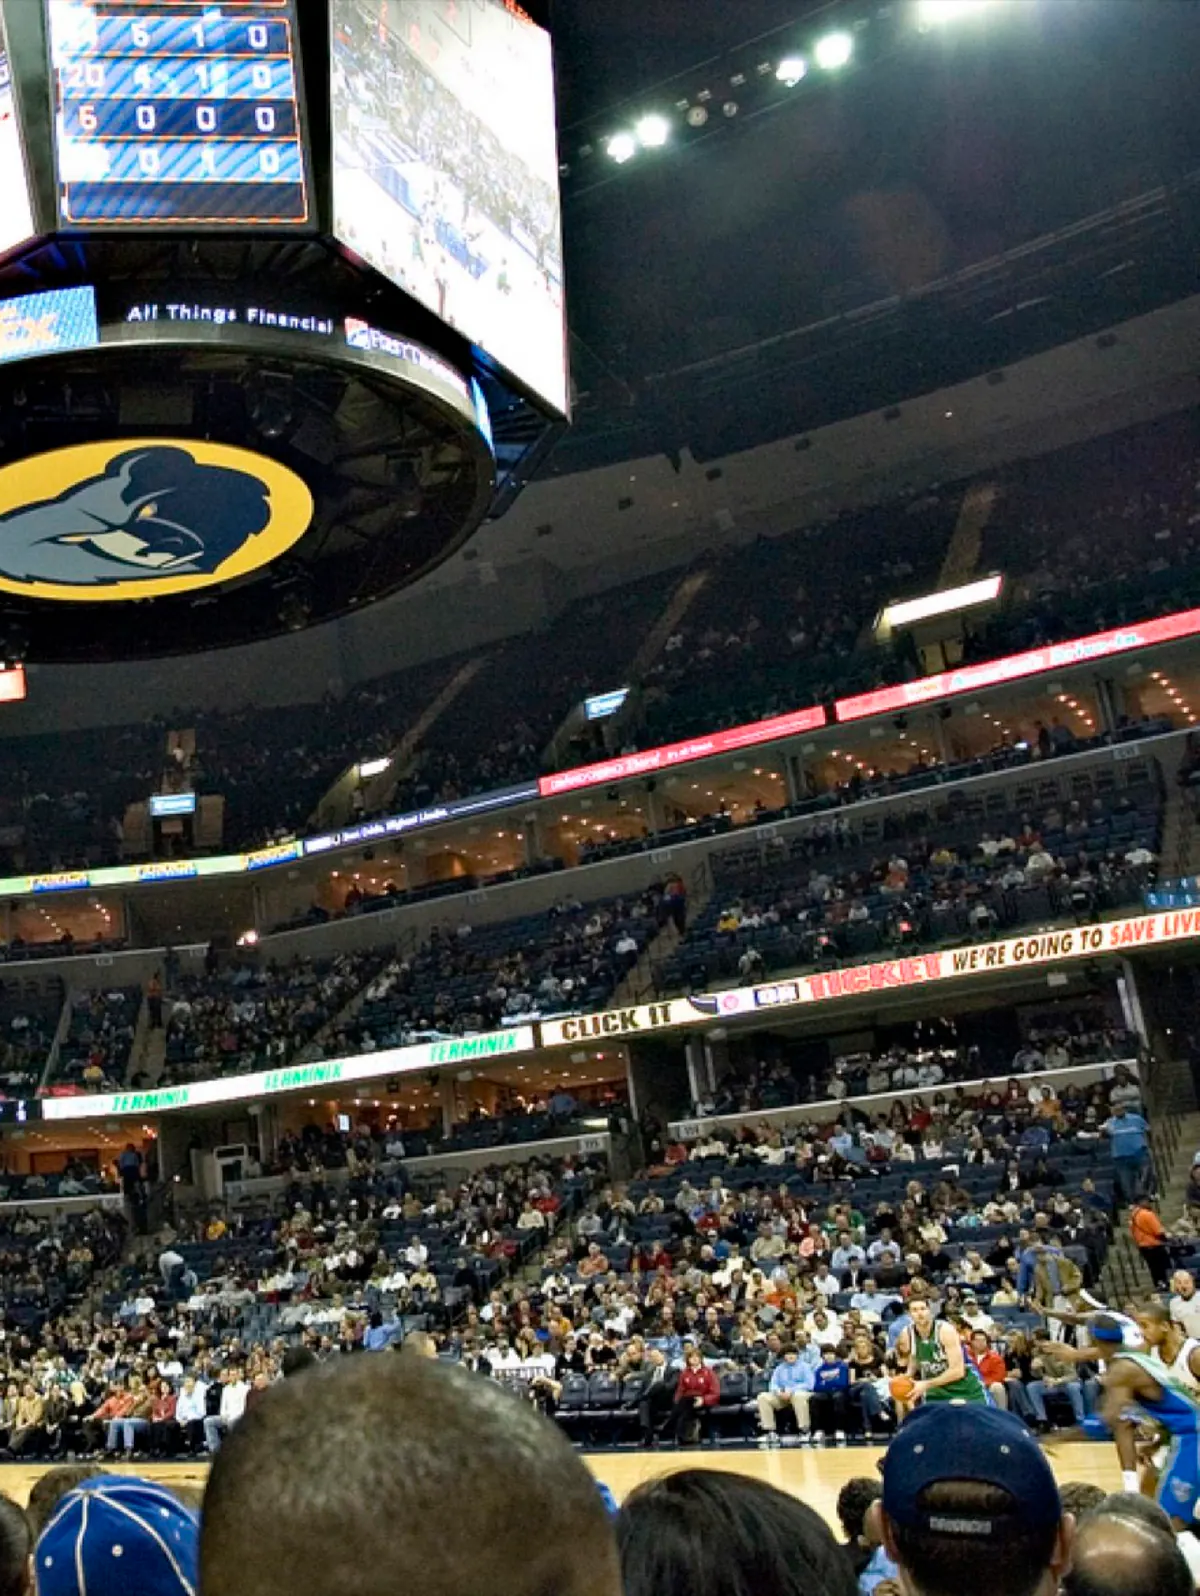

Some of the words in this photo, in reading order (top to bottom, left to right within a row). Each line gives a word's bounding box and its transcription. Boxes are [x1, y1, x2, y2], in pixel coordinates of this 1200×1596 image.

[249, 25, 267, 48] 0
[253, 66, 272, 89] 0
[136, 105, 156, 130] 0
[196, 106, 216, 130] 0
[255, 107, 275, 131] 0
[259, 149, 280, 173] 0
[127, 304, 158, 321] All
[165, 304, 237, 324] Things
[247, 308, 343, 334] Financial
[952, 948, 1006, 971] WE'RE
[1012, 933, 1073, 962] GOING
[1080, 927, 1103, 949] TO
[1110, 917, 1155, 946] SAVE
[806, 953, 943, 999] TICKET
[561, 1009, 640, 1040] CLICK
[650, 1002, 673, 1026] IT
[429, 1032, 517, 1063] TERMINIX
[111, 1088, 190, 1112] TERMINIX
